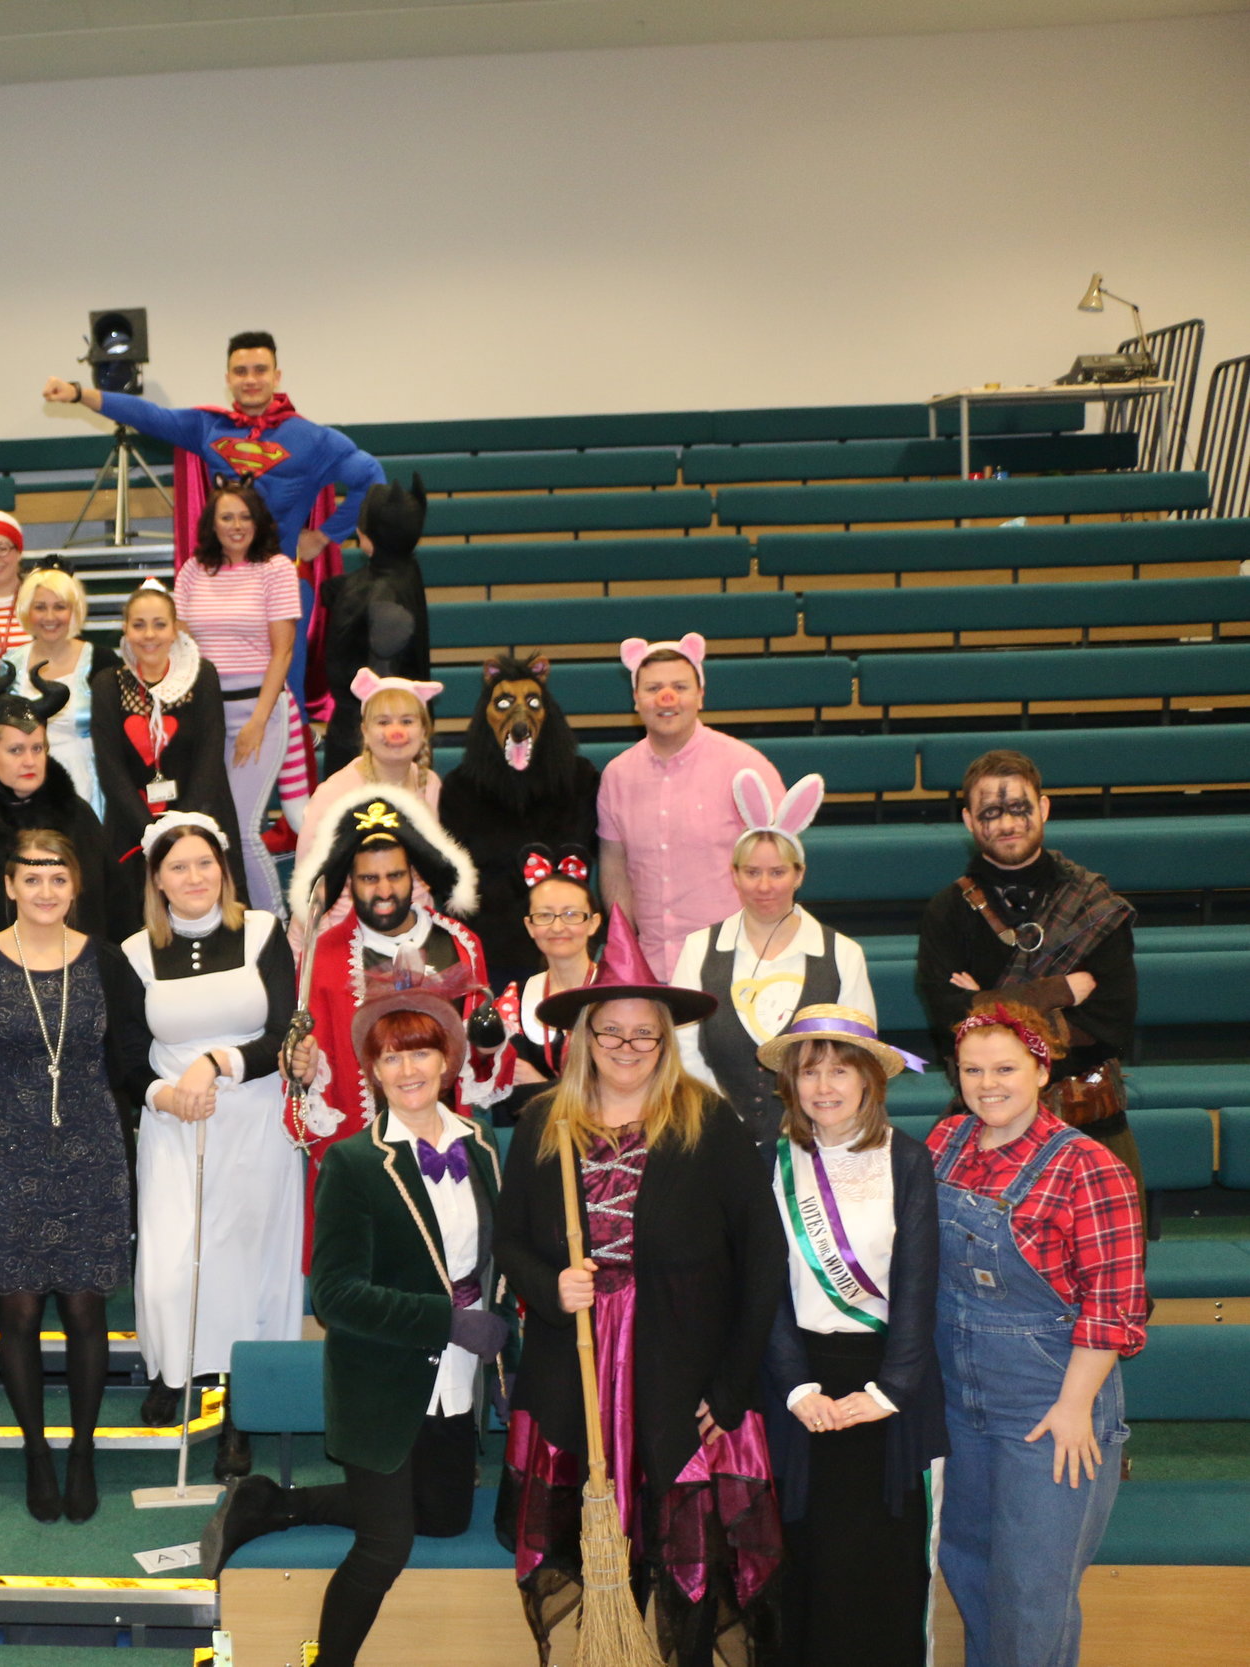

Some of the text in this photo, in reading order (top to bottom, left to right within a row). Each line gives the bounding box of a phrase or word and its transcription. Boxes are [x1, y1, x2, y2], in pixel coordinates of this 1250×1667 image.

[798, 1195, 863, 1300] VOTES FOR WOMEN
[158, 1554, 175, 1564] A
